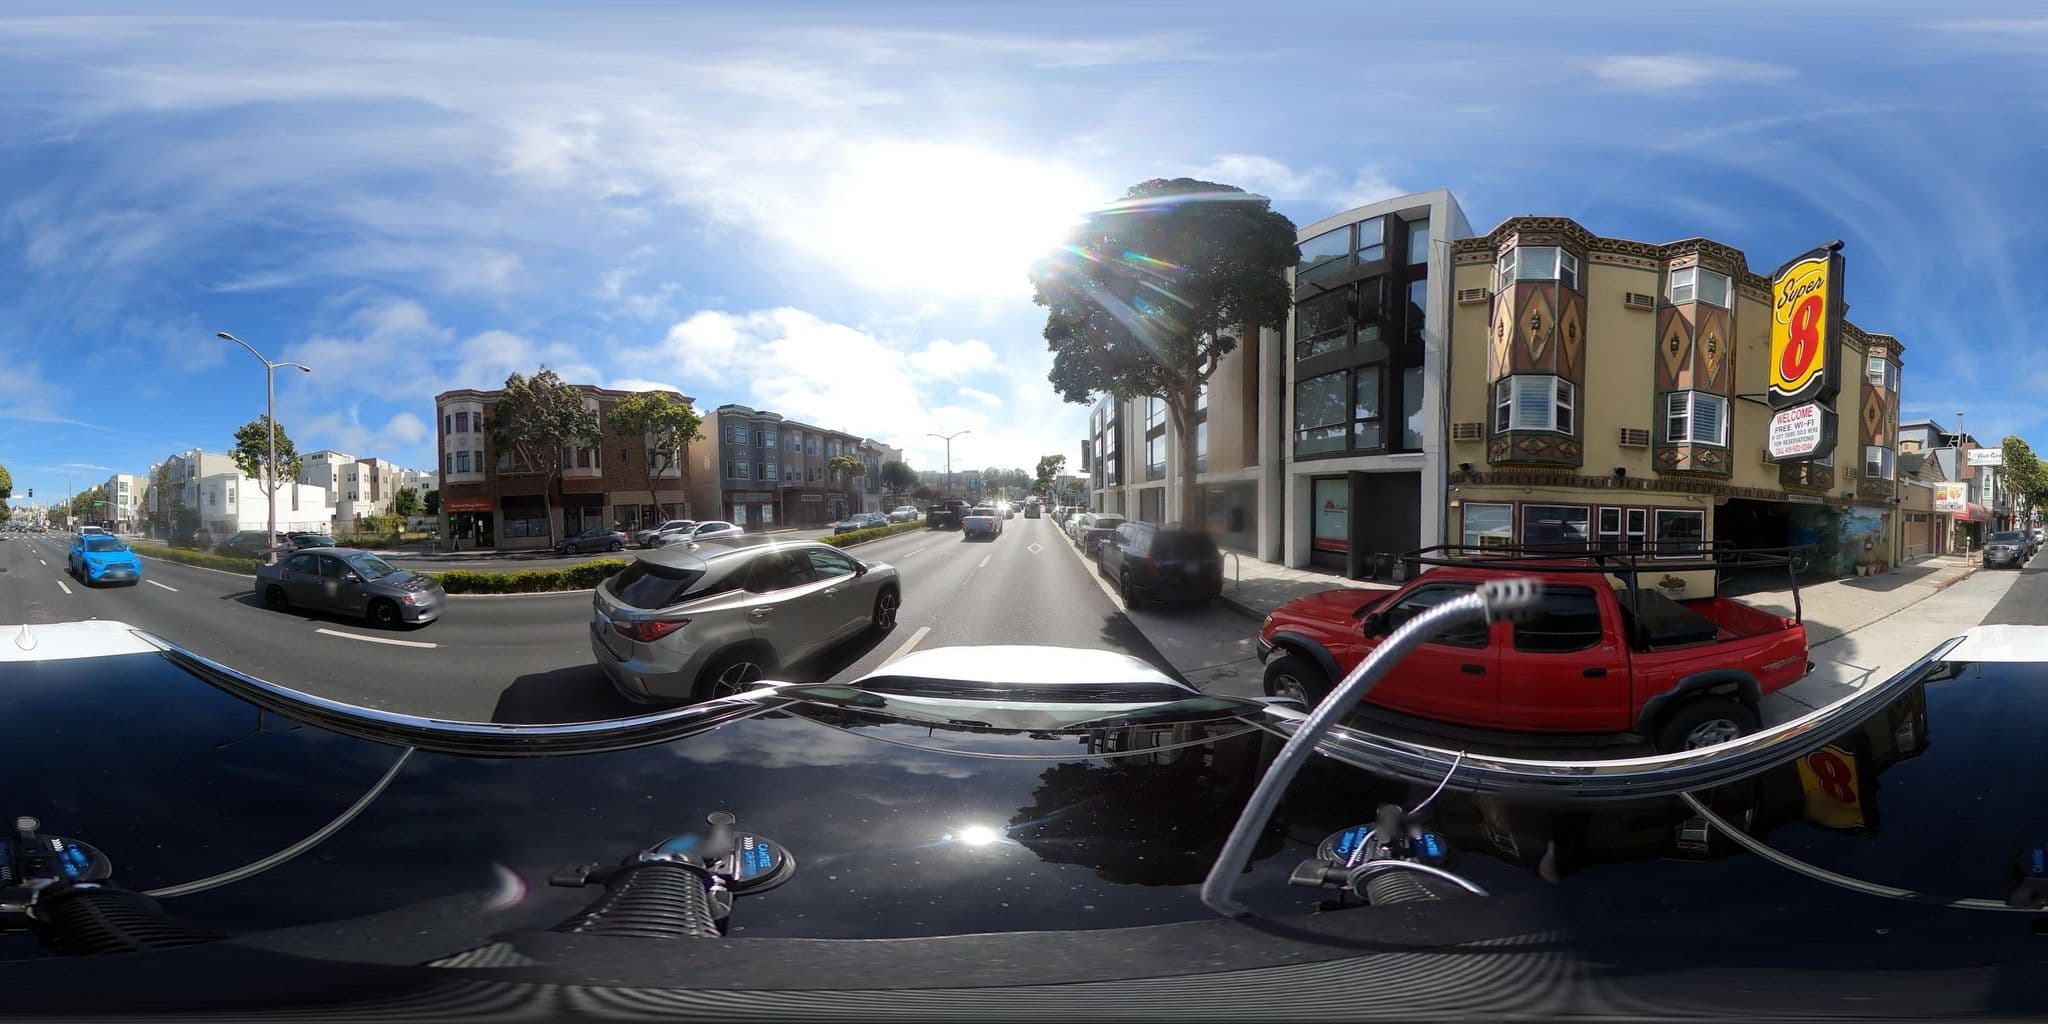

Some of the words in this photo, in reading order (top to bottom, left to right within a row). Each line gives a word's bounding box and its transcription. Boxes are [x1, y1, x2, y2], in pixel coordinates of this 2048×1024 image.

[1777, 276, 1824, 318] Super
[1779, 294, 1823, 382] 8
[1775, 424, 1791, 433] FREE
[1794, 419, 1814, 429] WI-FI
[1777, 406, 1813, 424] WELCOME
